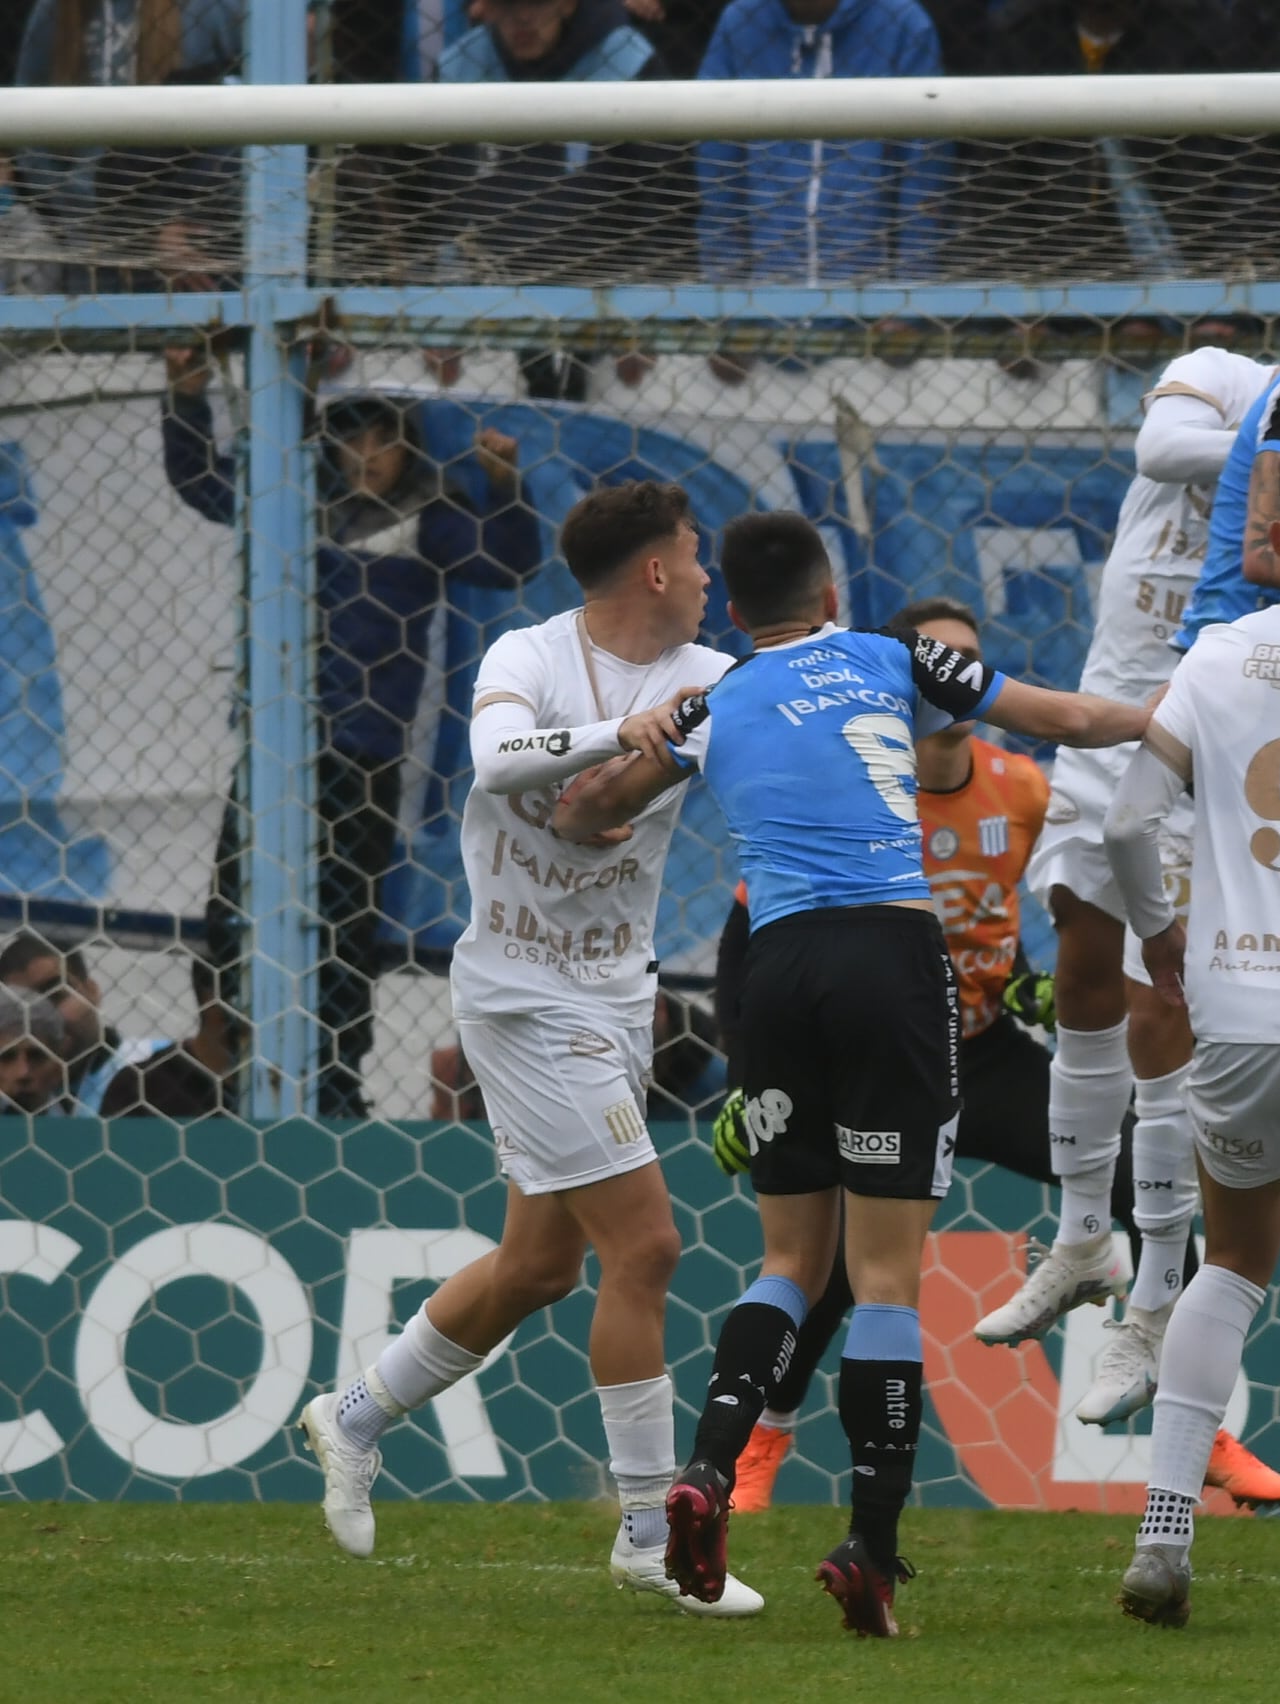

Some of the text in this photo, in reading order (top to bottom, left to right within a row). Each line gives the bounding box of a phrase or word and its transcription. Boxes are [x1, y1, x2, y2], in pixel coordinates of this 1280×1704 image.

[497, 737, 545, 754] LYON
[772, 1330, 797, 1384] mitre
[886, 1378, 910, 1430] mitre
